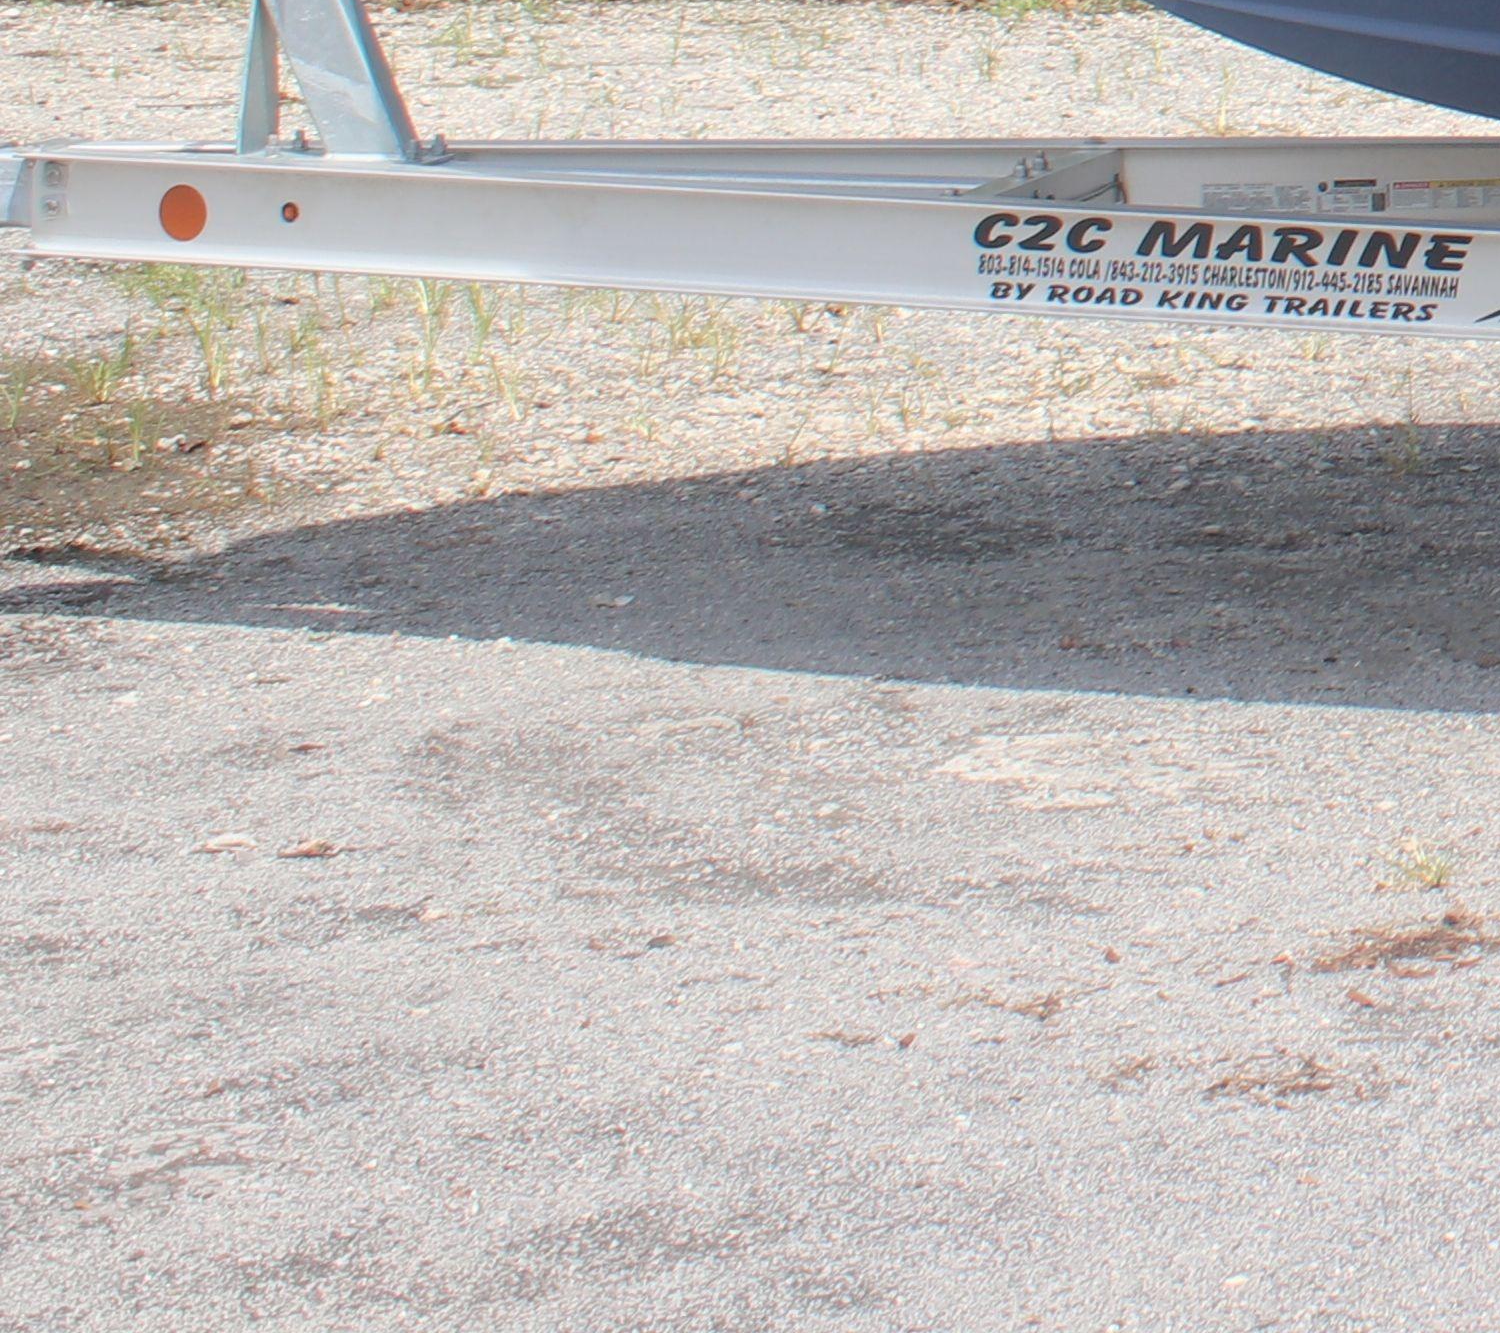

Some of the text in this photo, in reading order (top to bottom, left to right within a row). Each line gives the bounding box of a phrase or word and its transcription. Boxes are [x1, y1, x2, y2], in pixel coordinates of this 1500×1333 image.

[974, 212, 1473, 271] C2C MARINE
[978, 253, 1064, 279] 803-814-1514
[1068, 258, 1100, 280] COLA
[1386, 274, 1460, 298] SAVANNAH
[990, 281, 1439, 322] BY ROAD KING TRAILERS
